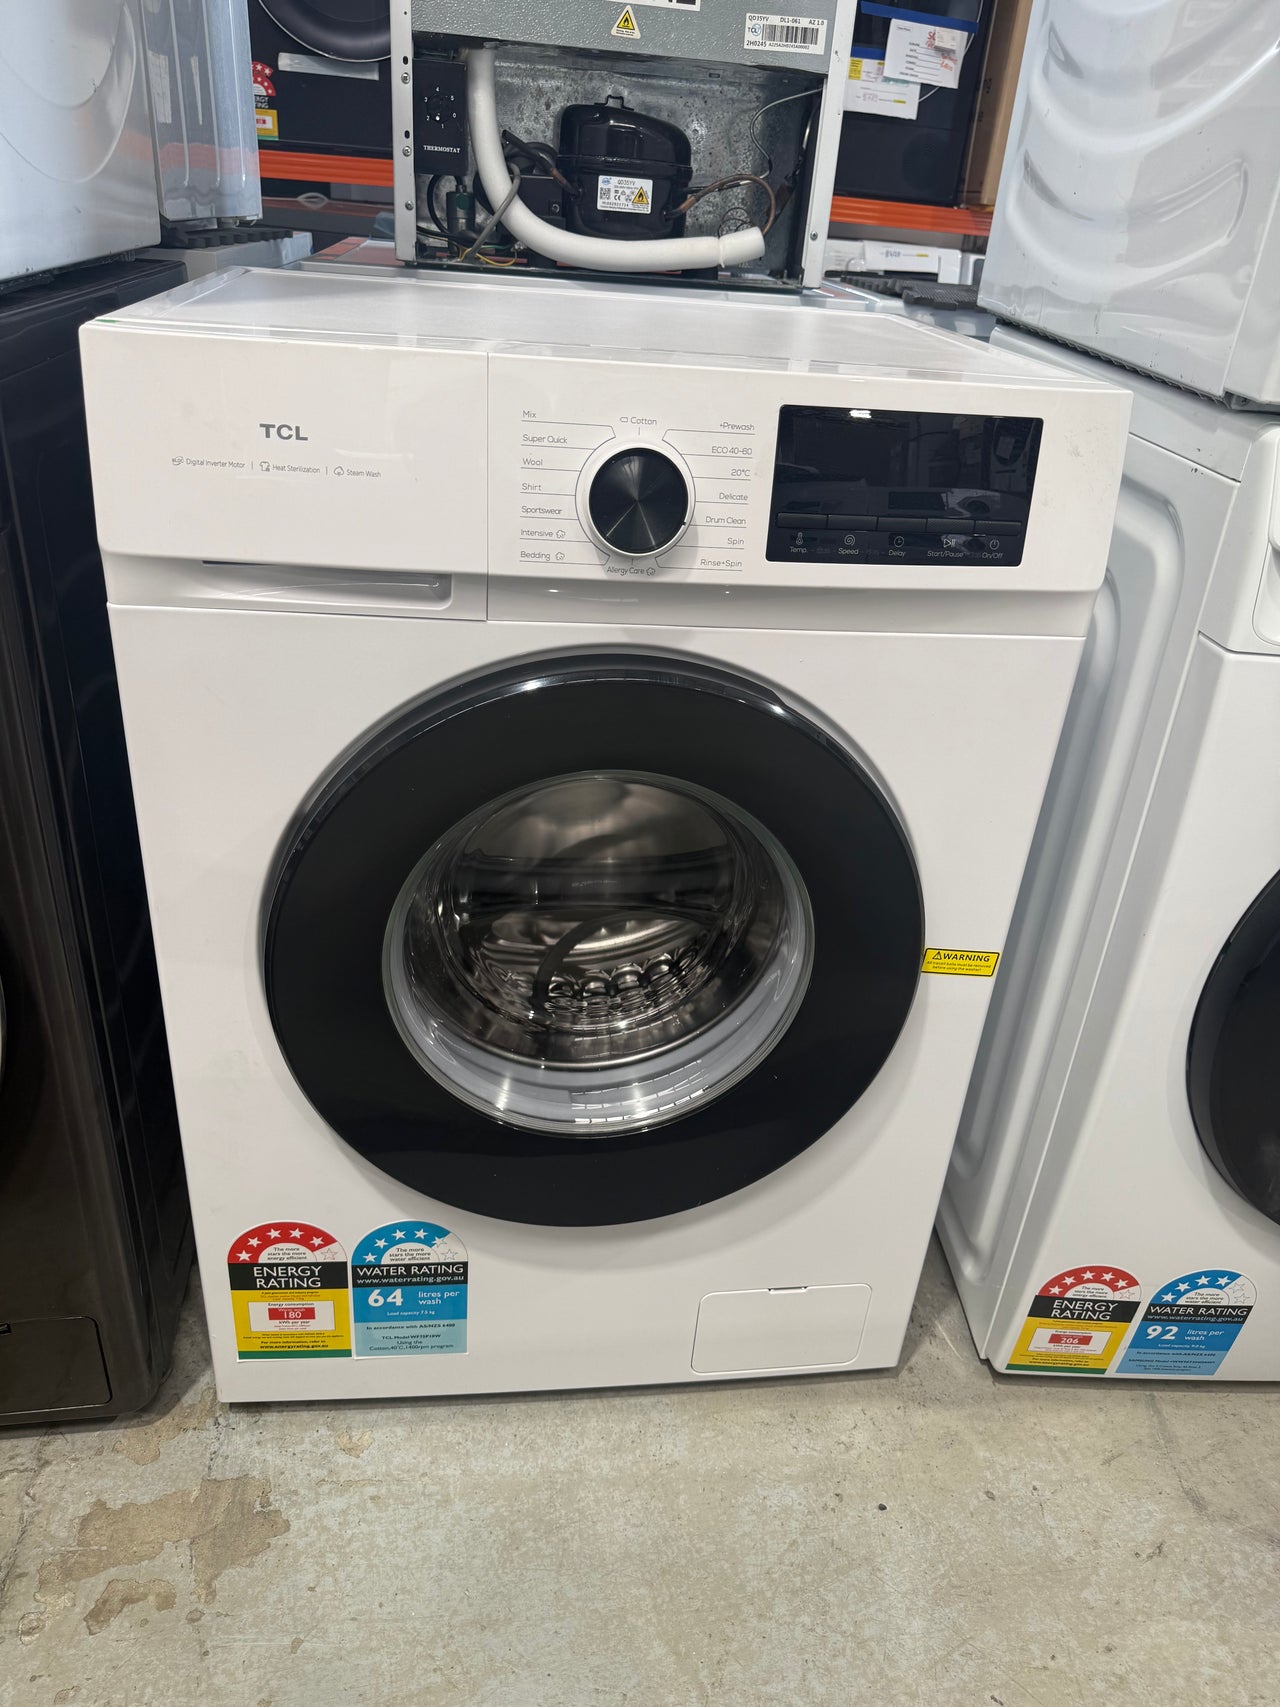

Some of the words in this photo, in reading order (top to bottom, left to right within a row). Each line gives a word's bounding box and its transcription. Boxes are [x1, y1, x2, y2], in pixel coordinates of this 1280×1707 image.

[423, 145, 461, 154] THERMOSTAT
[522, 410, 536, 418] Mix
[630, 417, 657, 425] Cotton
[720, 421, 754, 431] +Prewash
[259, 423, 308, 441] TCL
[522, 434, 546, 444] Super
[547, 435, 567, 444] Quick
[711, 446, 728, 454] ECO
[728, 447, 753, 455] 40-60
[186, 458, 204, 468] Digital
[206, 460, 227, 468] Inverter
[228, 461, 245, 469] Motor
[522, 458, 543, 466] Wool
[273, 464, 286, 472] Heat
[287, 465, 320, 474] Sterilization
[347, 469, 365, 477] Steam
[366, 470, 382, 478] Wash
[521, 483, 541, 491] Shirt
[719, 493, 748, 502] Delicate
[521, 506, 562, 515] Sportswear
[705, 516, 725, 524] Drum
[726, 517, 746, 525] Clean
[521, 529, 553, 537] Intensive
[727, 537, 744, 546] Spin
[520, 551, 550, 561] Bedding
[838, 547, 859, 556] Speed
[888, 549, 906, 558] Delay
[927, 550, 964, 558] Start/Pause
[982, 551, 1004, 560] On/Off
[700, 559, 742, 568] Rinse+Spin
[607, 566, 628, 576] Allergy
[629, 567, 644, 575] Care
[943, 953, 990, 963] WARNING
[253, 1265, 322, 1277] ENERGY
[357, 1266, 407, 1276] WATER
[411, 1264, 464, 1275] RATING
[256, 1277, 321, 1289] RATING
[356, 1275, 464, 1284] www.waterrating.gov.au
[368, 1288, 404, 1307] 64
[444, 1291, 460, 1299] per
[1053, 1300, 1118, 1311] ENERGY
[284, 1311, 302, 1319] 180
[1051, 1309, 1112, 1321] RATING
[1150, 1306, 1194, 1315] WATER
[1198, 1307, 1249, 1316] RATING
[1146, 1315, 1244, 1323] www.waterrating.gov.au
[1146, 1325, 1179, 1340] 92
